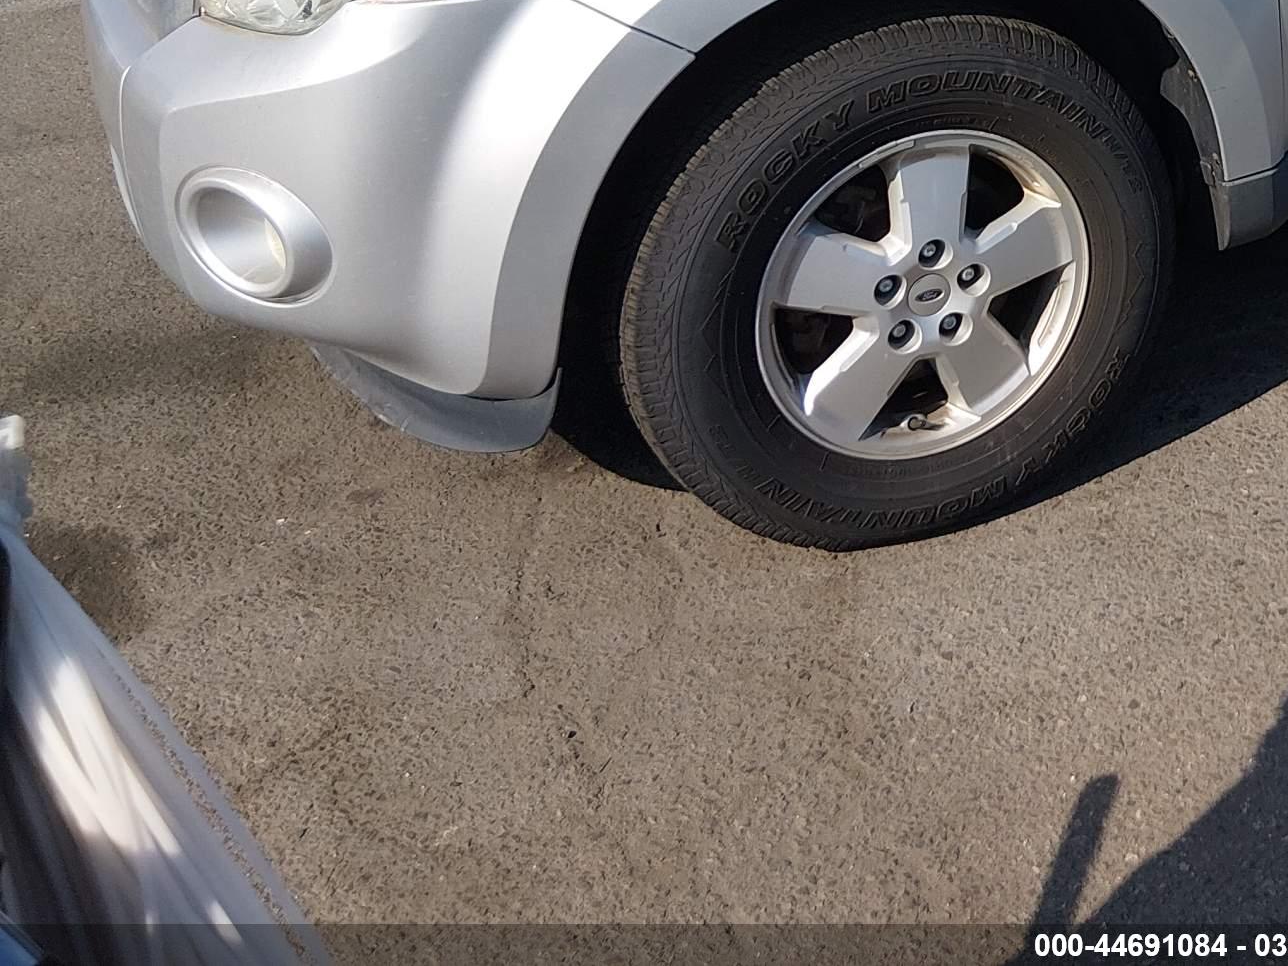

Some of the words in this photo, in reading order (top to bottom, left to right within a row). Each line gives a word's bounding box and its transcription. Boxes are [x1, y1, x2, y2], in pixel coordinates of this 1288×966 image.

[715, 100, 854, 252] ROCKY
[866, 70, 1107, 140] MOUNTAIN
[1016, 346, 1132, 486] ROCKY
